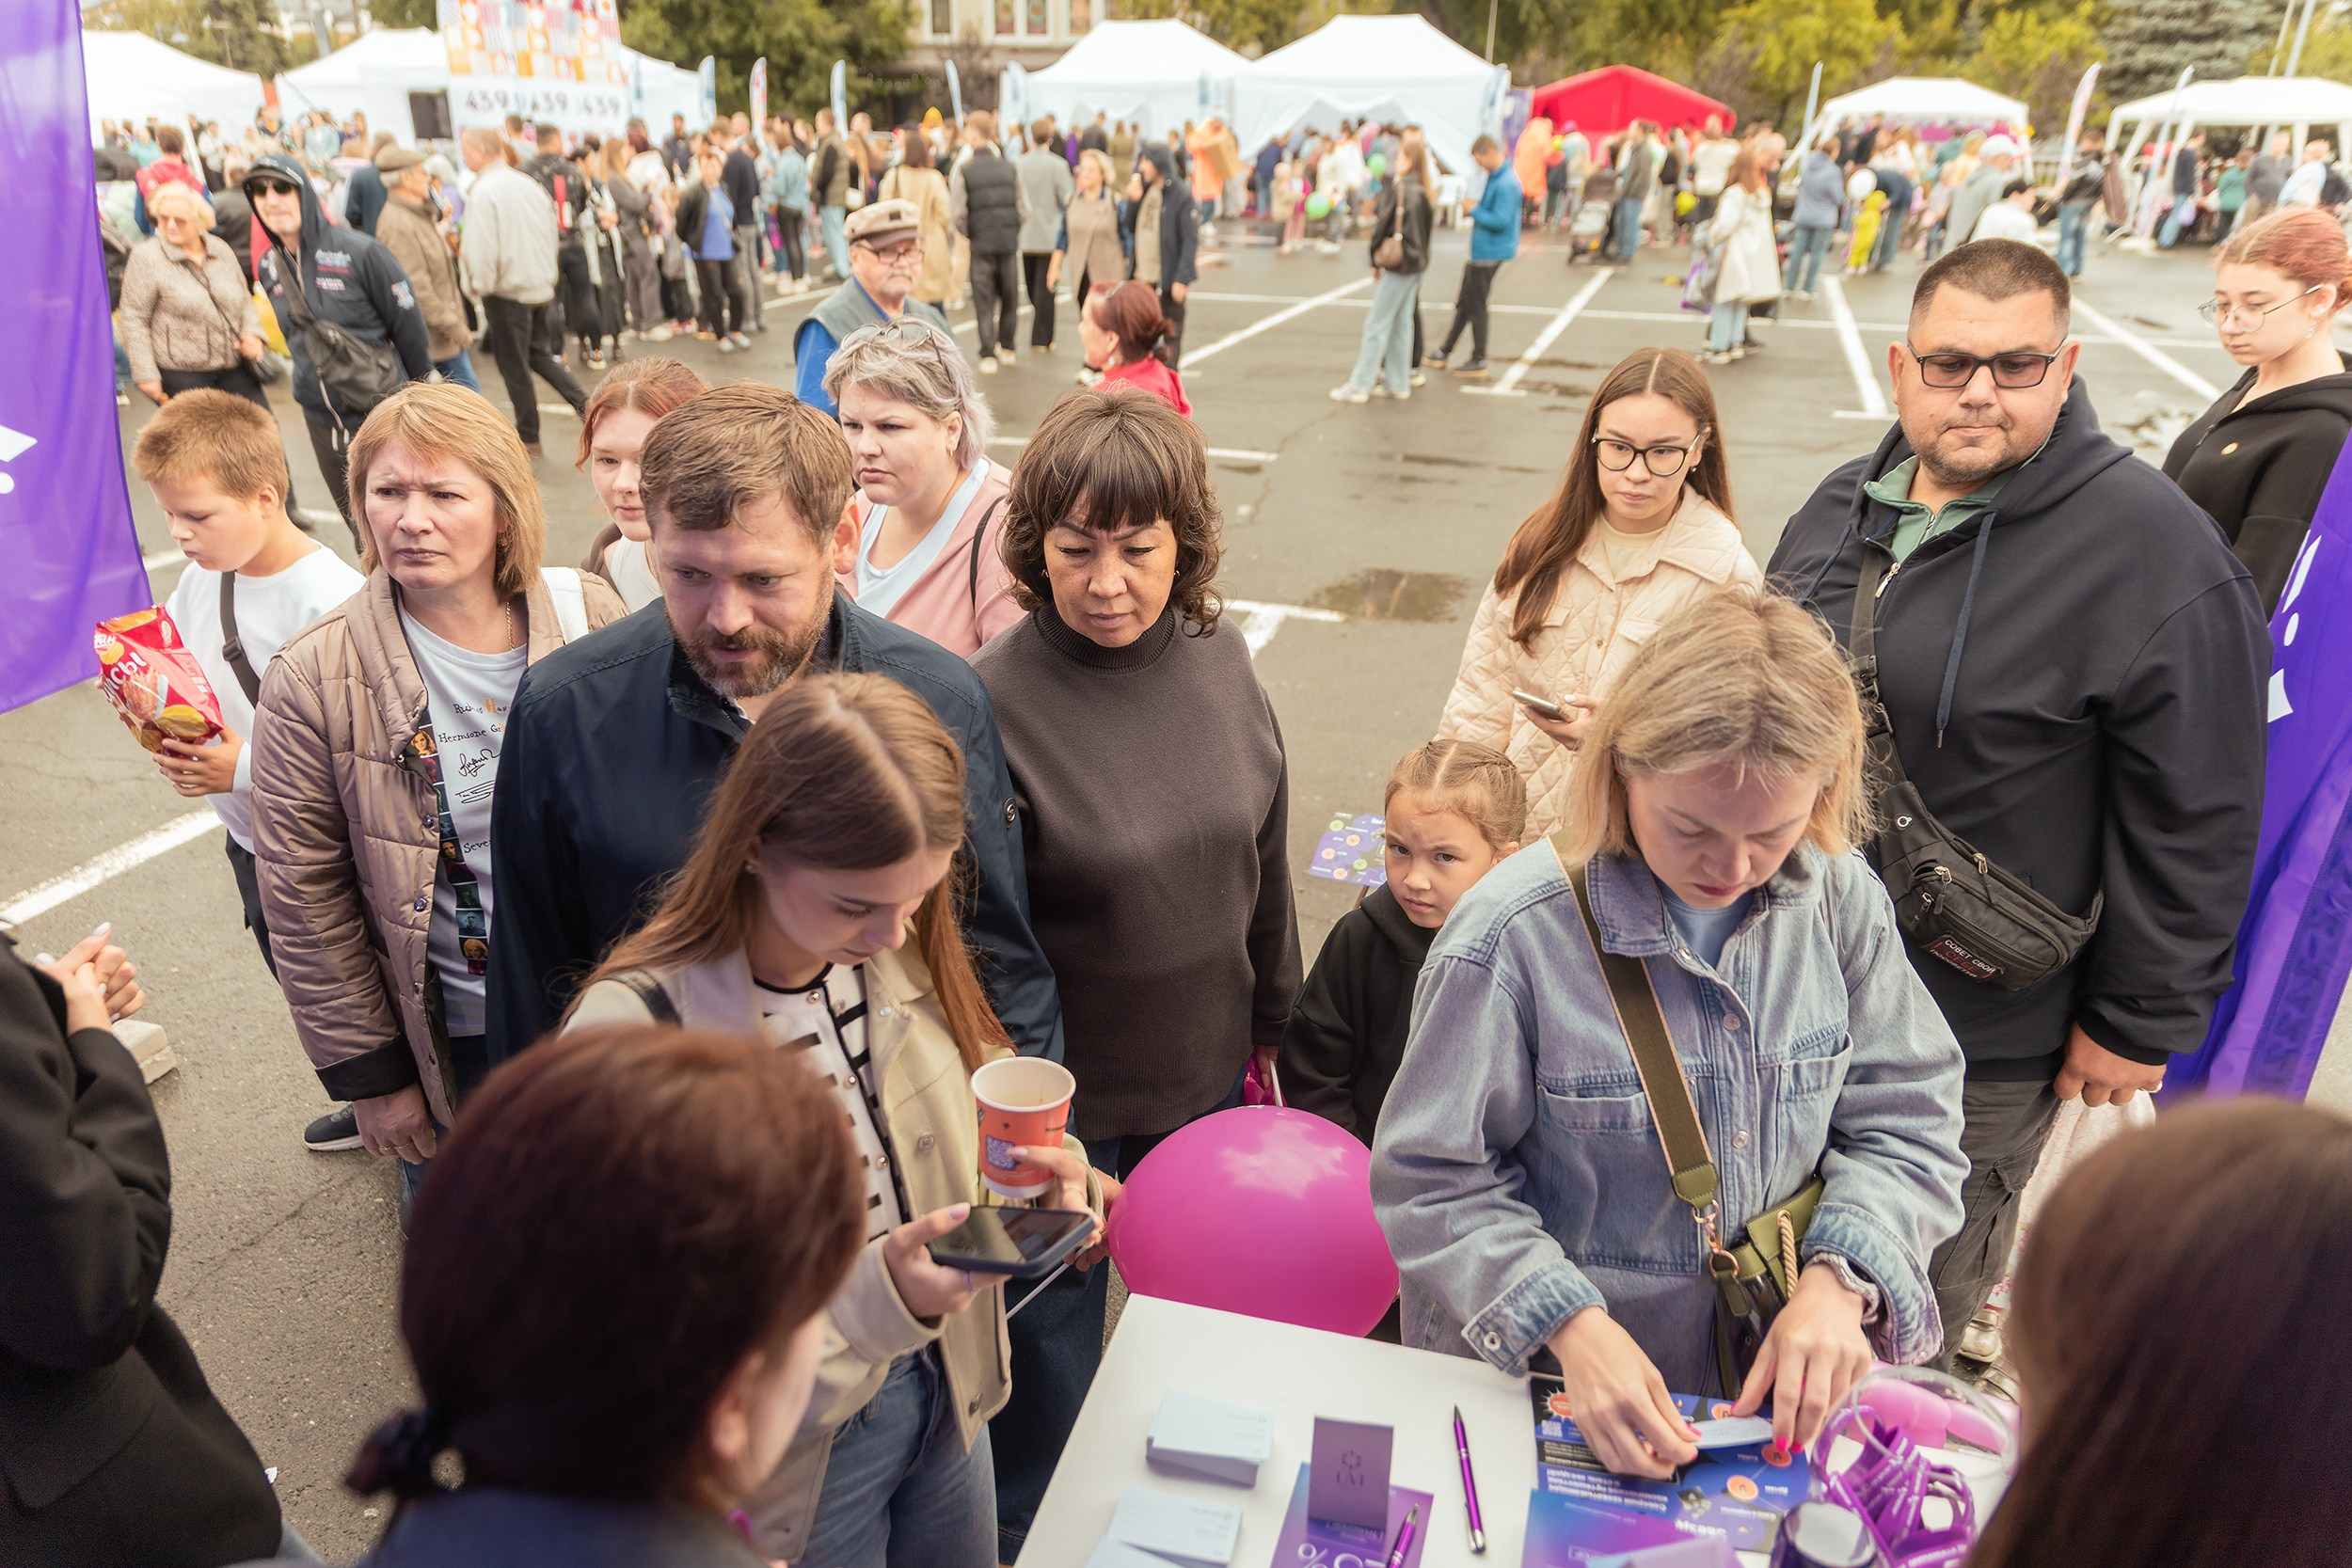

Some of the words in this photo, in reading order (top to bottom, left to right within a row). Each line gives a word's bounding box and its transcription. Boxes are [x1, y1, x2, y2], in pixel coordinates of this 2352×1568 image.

[438, 729, 487, 743] Hermione
[1945, 939, 1973, 959] СОВЕТ
[1945, 950, 1980, 974] СЕБЕ
